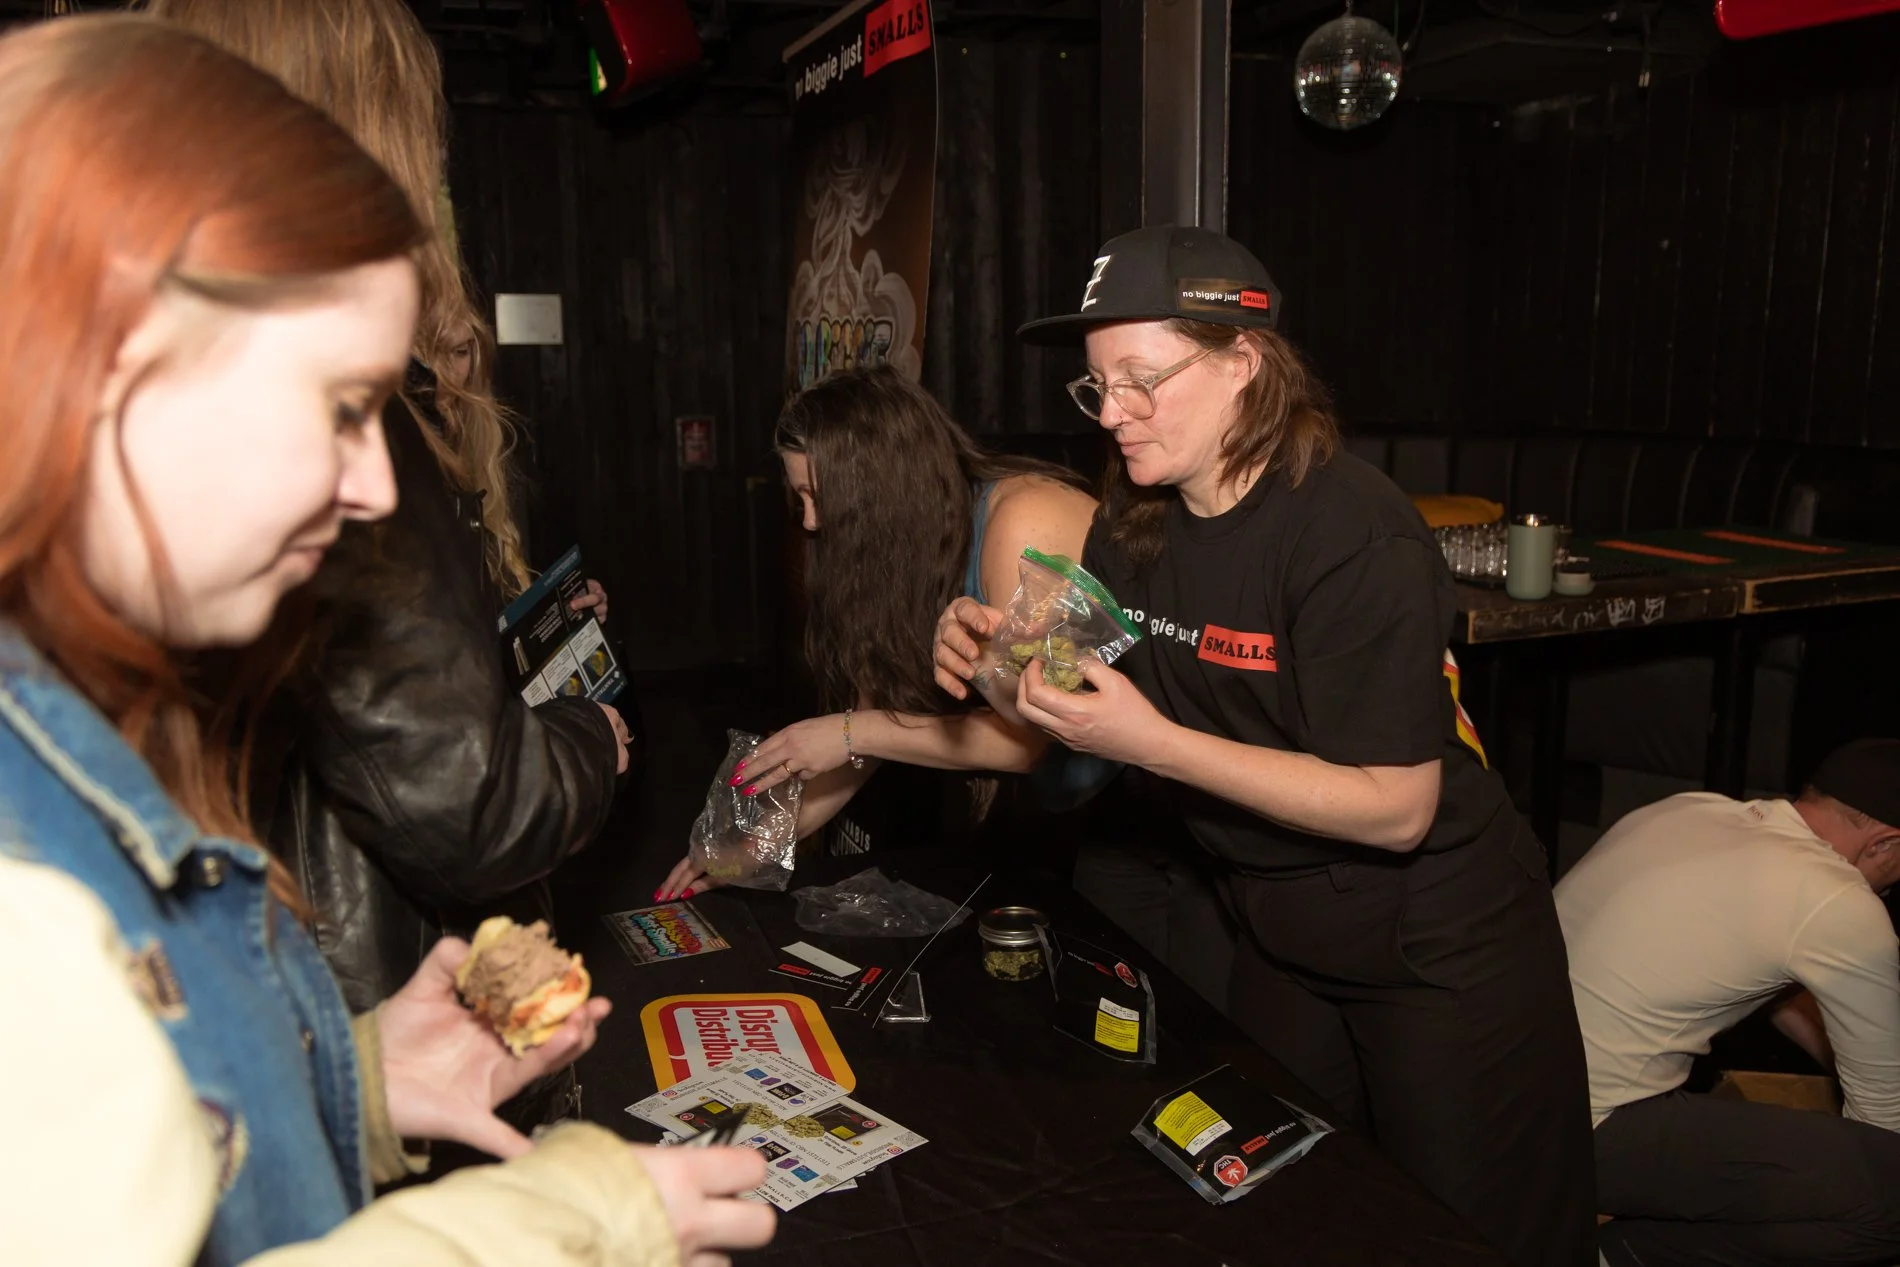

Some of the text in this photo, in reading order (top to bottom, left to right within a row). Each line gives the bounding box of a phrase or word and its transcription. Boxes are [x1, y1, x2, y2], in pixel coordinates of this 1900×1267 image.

[804, 53, 838, 94] biggie
[839, 33, 863, 81] just
[867, 2, 925, 57] SMALLS
[1182, 290, 1195, 299] no
[1195, 290, 1223, 301] biggie
[1223, 292, 1240, 302] just
[1122, 607, 1145, 623] no
[1174, 622, 1198, 647] just
[1203, 636, 1278, 662] SMALLS
[691, 1008, 739, 1067] Distribu
[1218, 1159, 1232, 1170] THC
